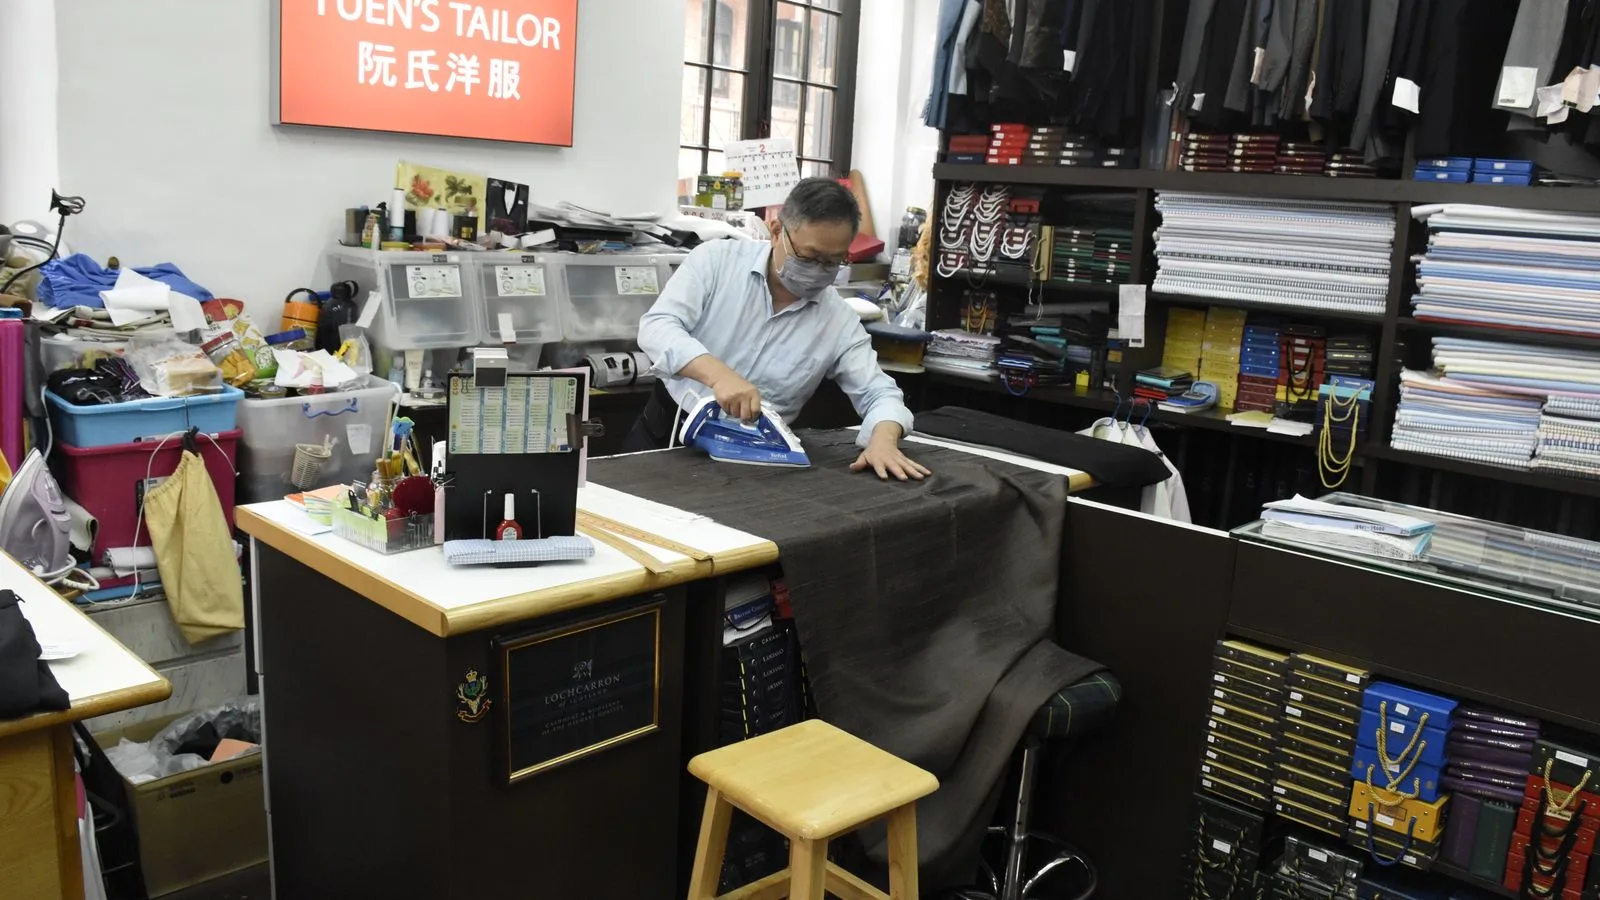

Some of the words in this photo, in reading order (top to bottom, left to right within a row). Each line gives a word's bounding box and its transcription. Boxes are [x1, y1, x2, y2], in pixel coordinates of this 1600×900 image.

[448, 3, 561, 50] TAILOR
[357, 40, 521, 100] 阮氏洋服
[759, 143, 766, 153] 2
[544, 673, 621, 705] LOCHCARRON
